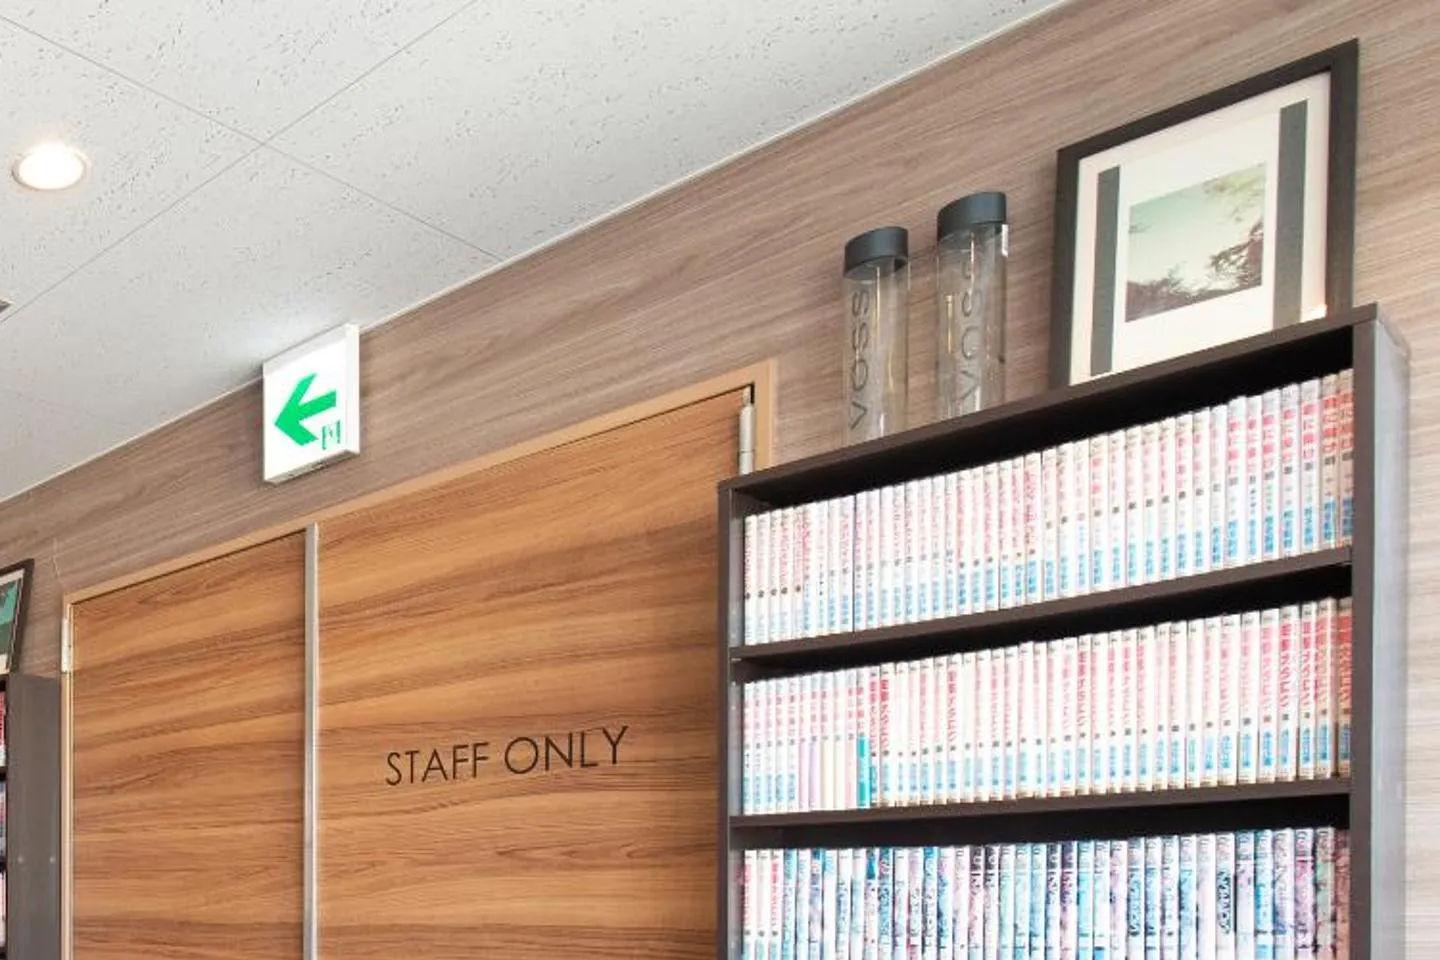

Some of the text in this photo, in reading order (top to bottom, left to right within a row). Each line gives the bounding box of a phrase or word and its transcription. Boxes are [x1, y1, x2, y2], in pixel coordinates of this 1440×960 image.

[849, 288, 871, 431] VOSS
[384, 724, 629, 787] STAFF ONLY
